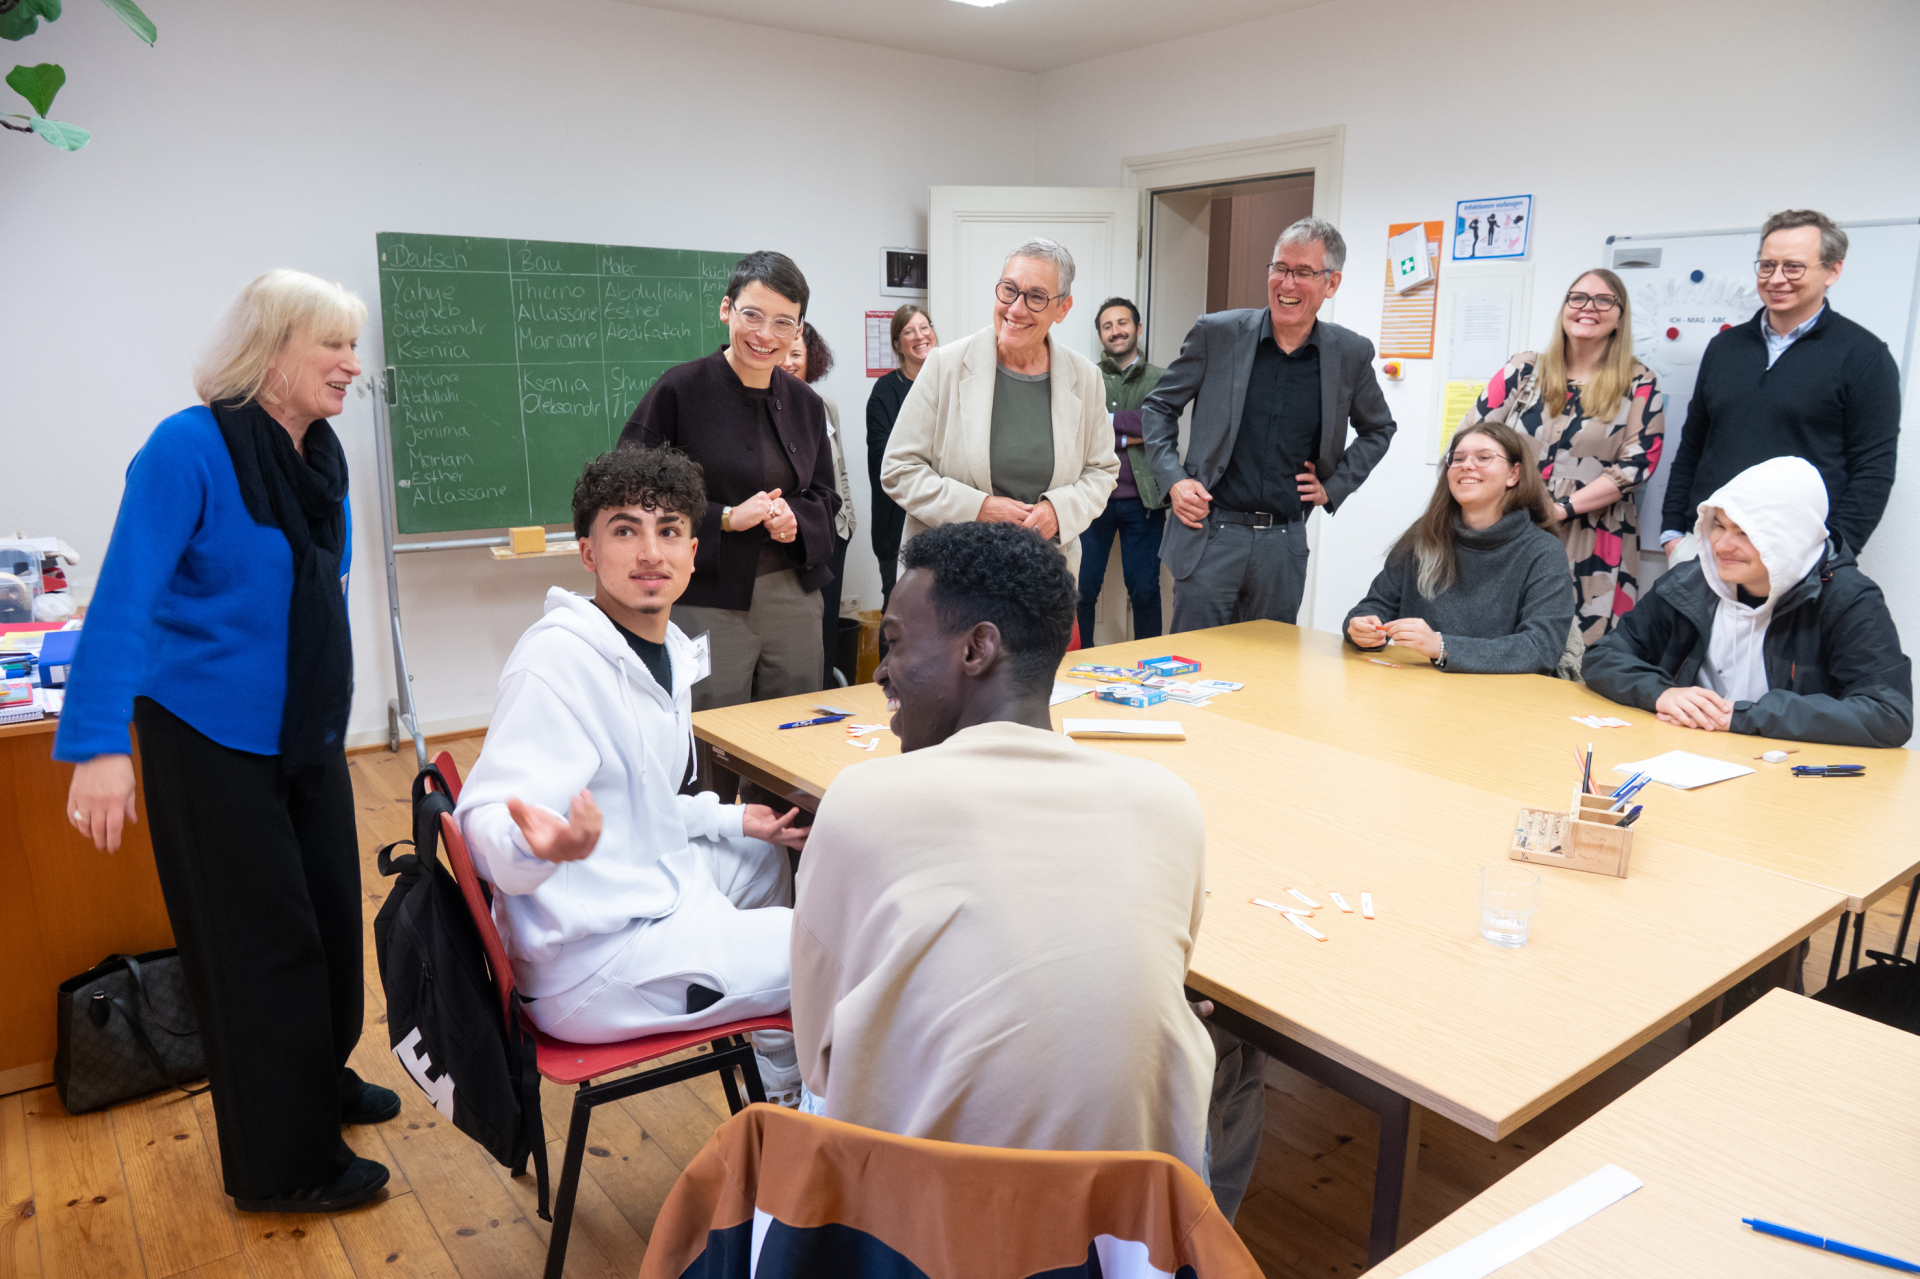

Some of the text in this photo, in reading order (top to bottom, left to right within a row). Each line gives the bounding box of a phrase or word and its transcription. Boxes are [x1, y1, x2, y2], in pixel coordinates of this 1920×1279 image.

[388, 244, 467, 269] Deutsch
[517, 248, 563, 272] Bau
[511, 278, 585, 301] Thierno
[518, 303, 599, 323] Allassane
[604, 302, 662, 320] Esther
[406, 424, 470, 447] Jemima
[412, 470, 464, 485] Esther
[413, 485, 507, 507] Allassane
